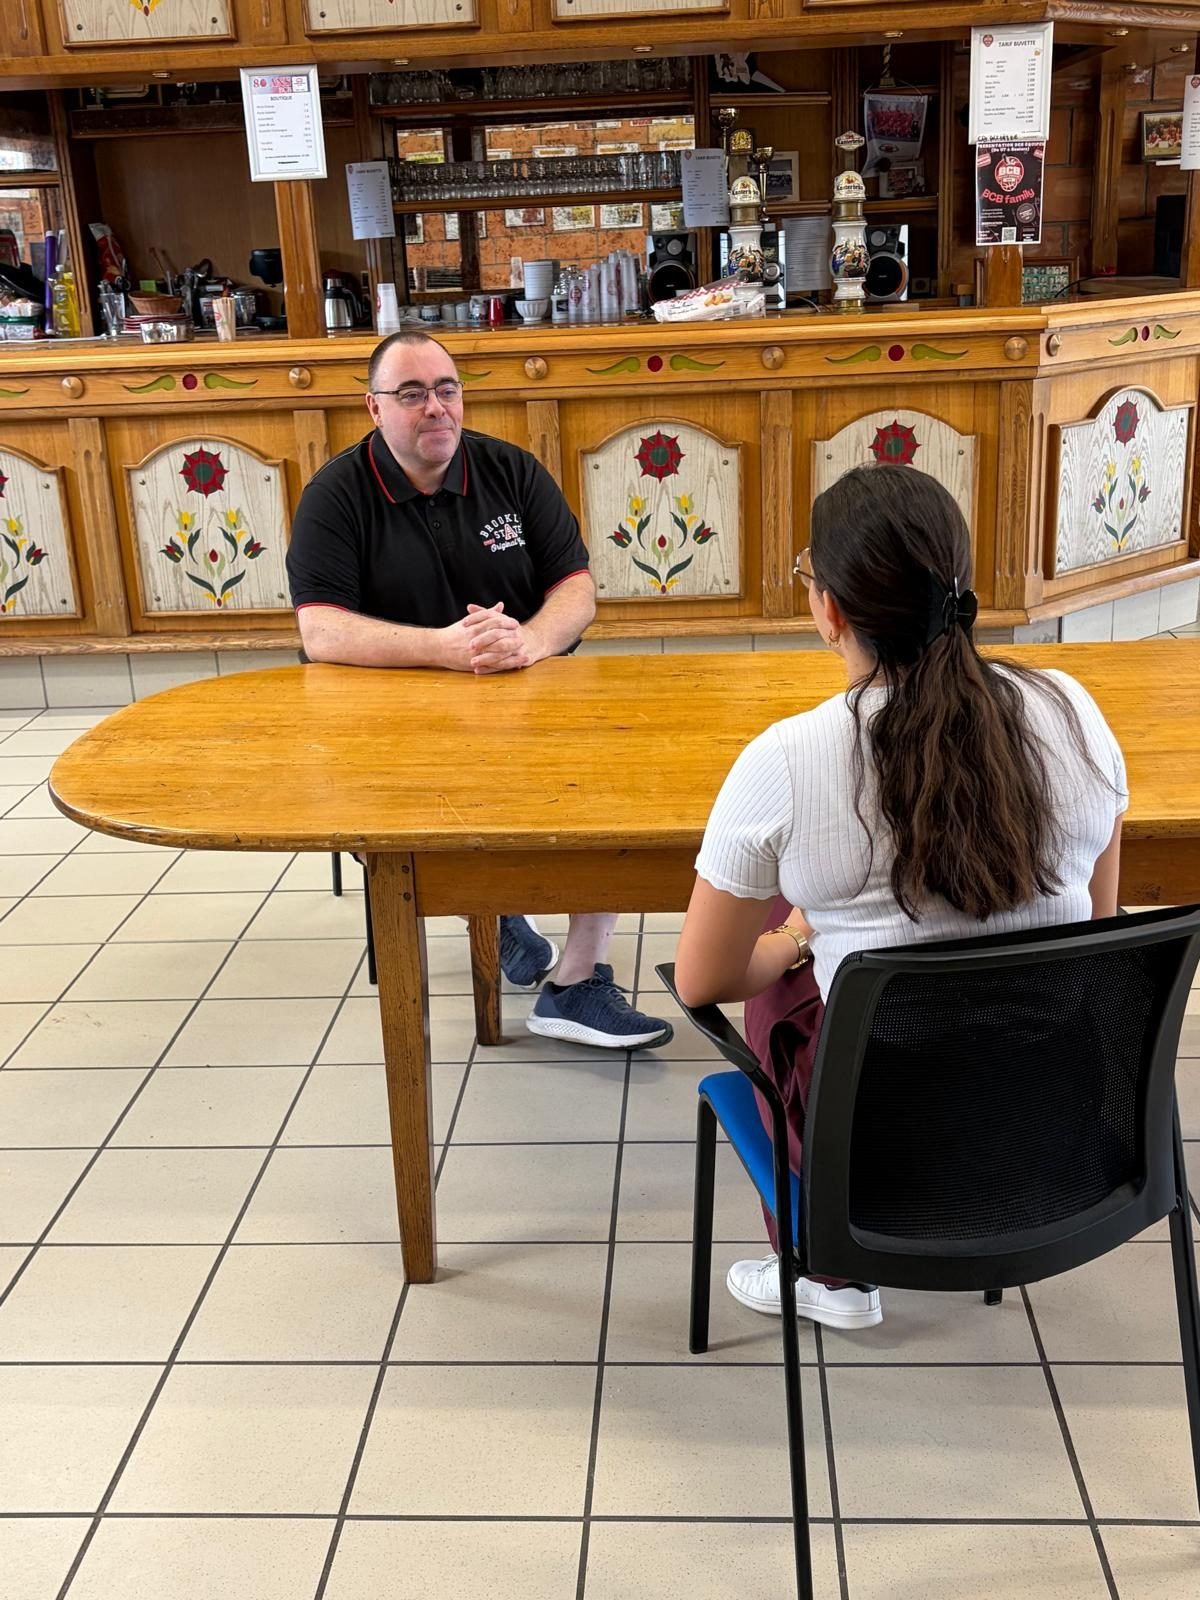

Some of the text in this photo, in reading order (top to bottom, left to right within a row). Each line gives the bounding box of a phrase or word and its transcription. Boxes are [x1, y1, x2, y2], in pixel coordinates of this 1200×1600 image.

[982, 188, 1035, 204] BCB family
[480, 513, 521, 539] BROOKL
[493, 523, 523, 541] STATE
